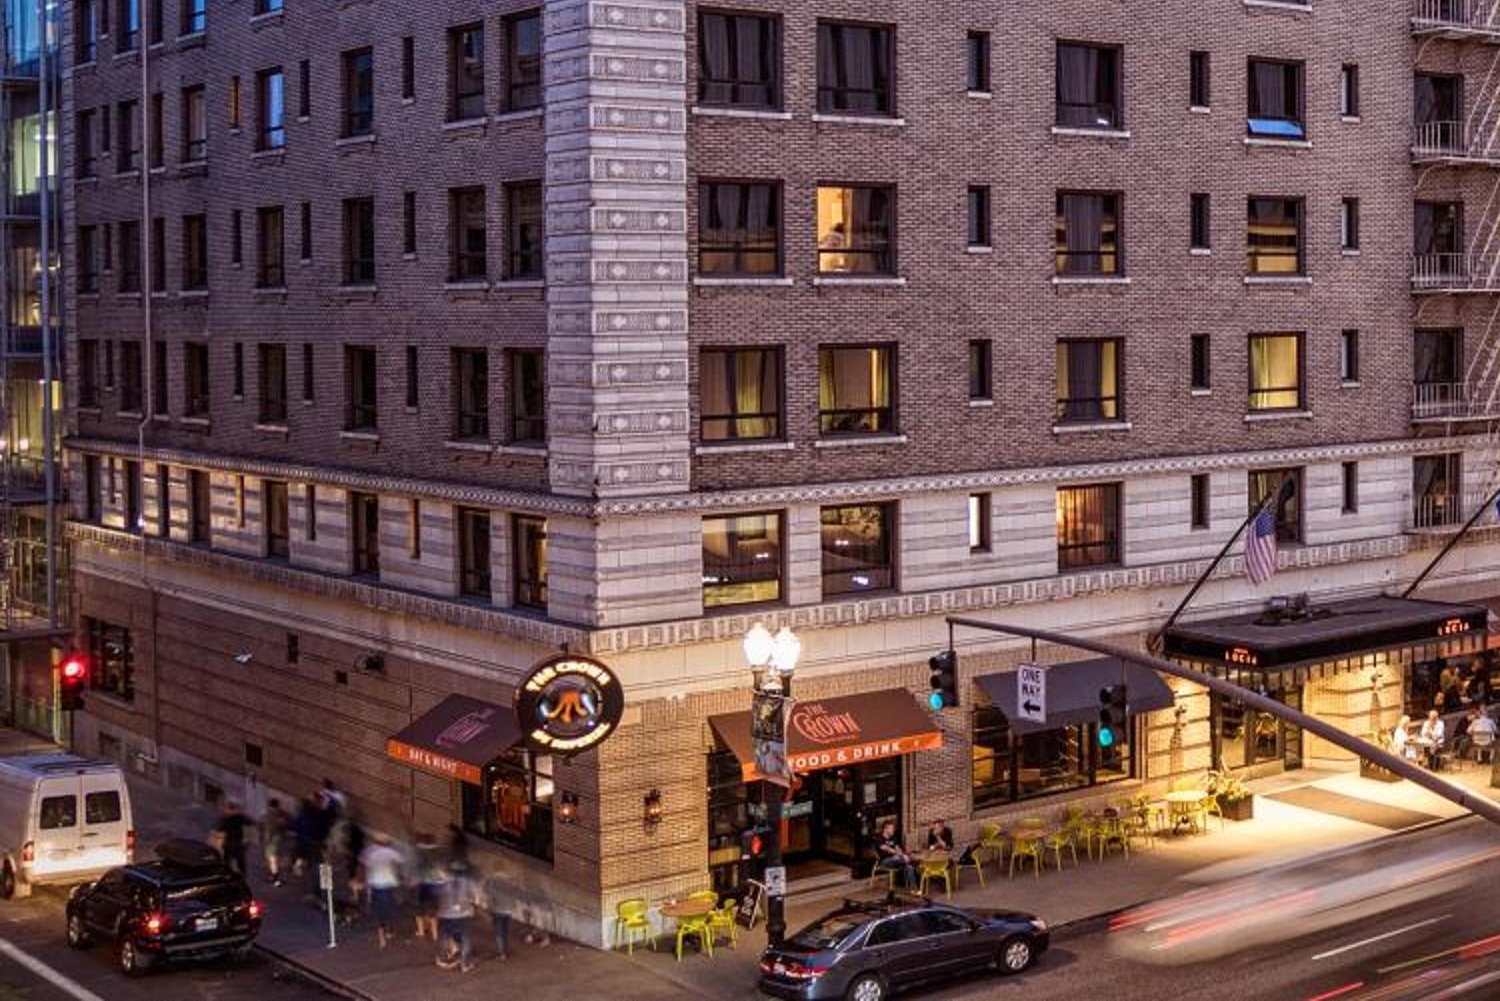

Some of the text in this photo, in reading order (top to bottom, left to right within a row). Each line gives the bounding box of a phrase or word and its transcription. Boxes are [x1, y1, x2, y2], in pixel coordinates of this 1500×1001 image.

[1021, 668, 1041, 684] ONE
[1021, 683, 1041, 698] WAY
[793, 711, 862, 744] CROWN
[836, 749, 847, 763] &
[853, 742, 900, 760] DRINK
